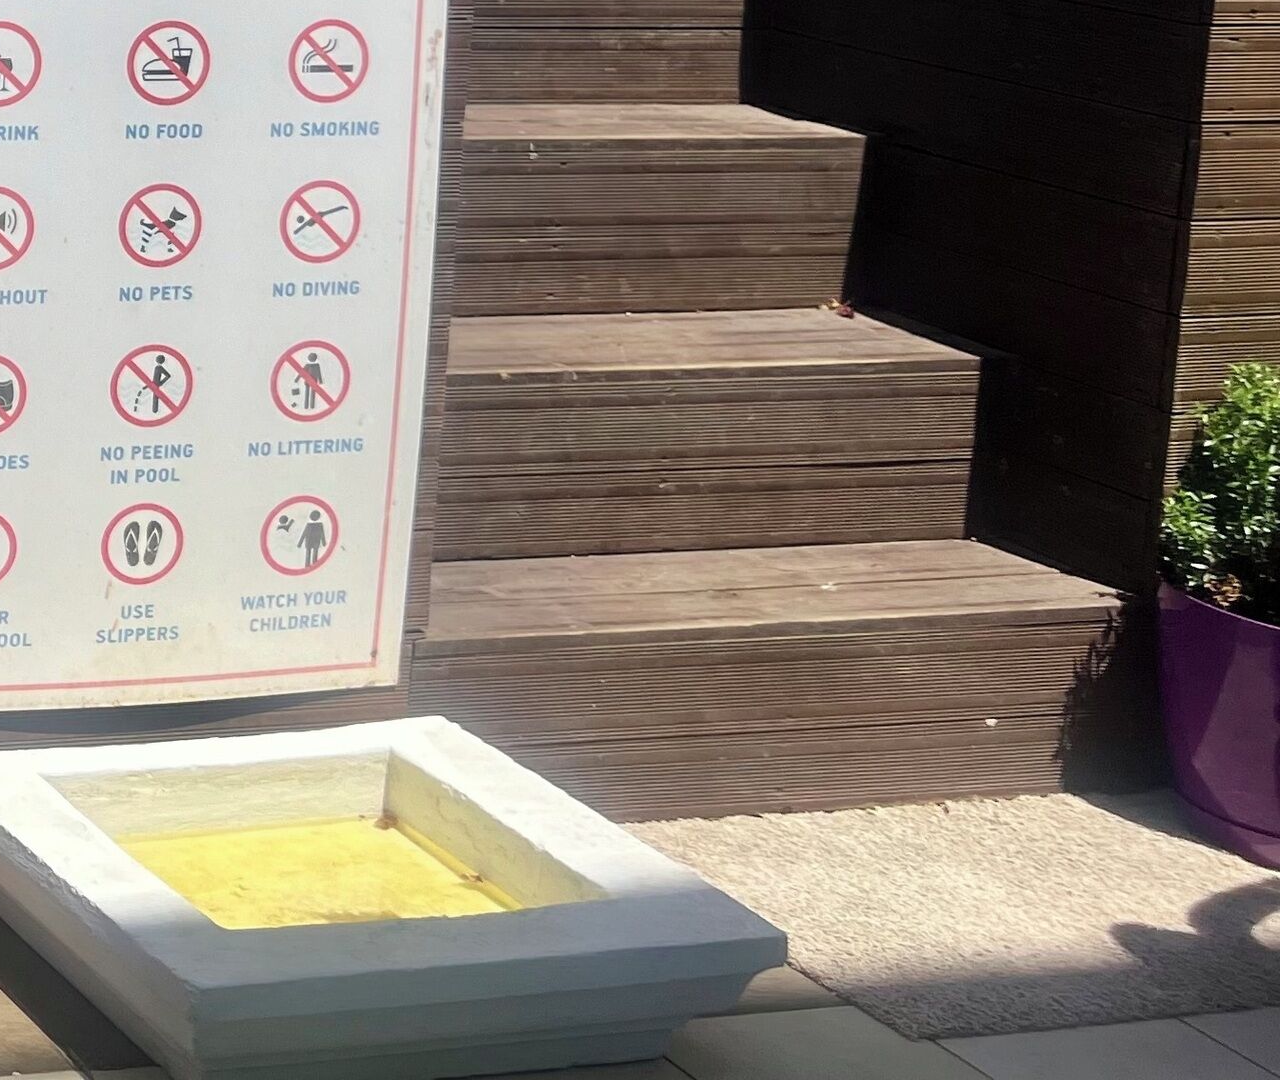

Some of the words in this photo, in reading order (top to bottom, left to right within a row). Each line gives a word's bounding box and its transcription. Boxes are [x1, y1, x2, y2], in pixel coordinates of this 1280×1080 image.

[125, 123, 150, 140] NO
[156, 123, 203, 139] FOOD
[270, 122, 295, 138] NO
[299, 120, 380, 137] SMOKING
[119, 286, 143, 302] NO
[149, 285, 193, 302] PETS
[272, 282, 296, 298] NO
[302, 280, 360, 297] DIVING
[100, 446, 125, 462] NO
[130, 443, 194, 461] PEEING
[247, 441, 272, 457] NO
[277, 437, 364, 456] LITTERING
[110, 469, 129, 485] IN
[134, 467, 181, 484] POOL
[240, 593, 299, 611] WATCH
[303, 589, 347, 607] YOUR
[119, 603, 155, 620] USE
[248, 613, 332, 633] CHILDREN
[95, 625, 179, 645] SLIPPERS
